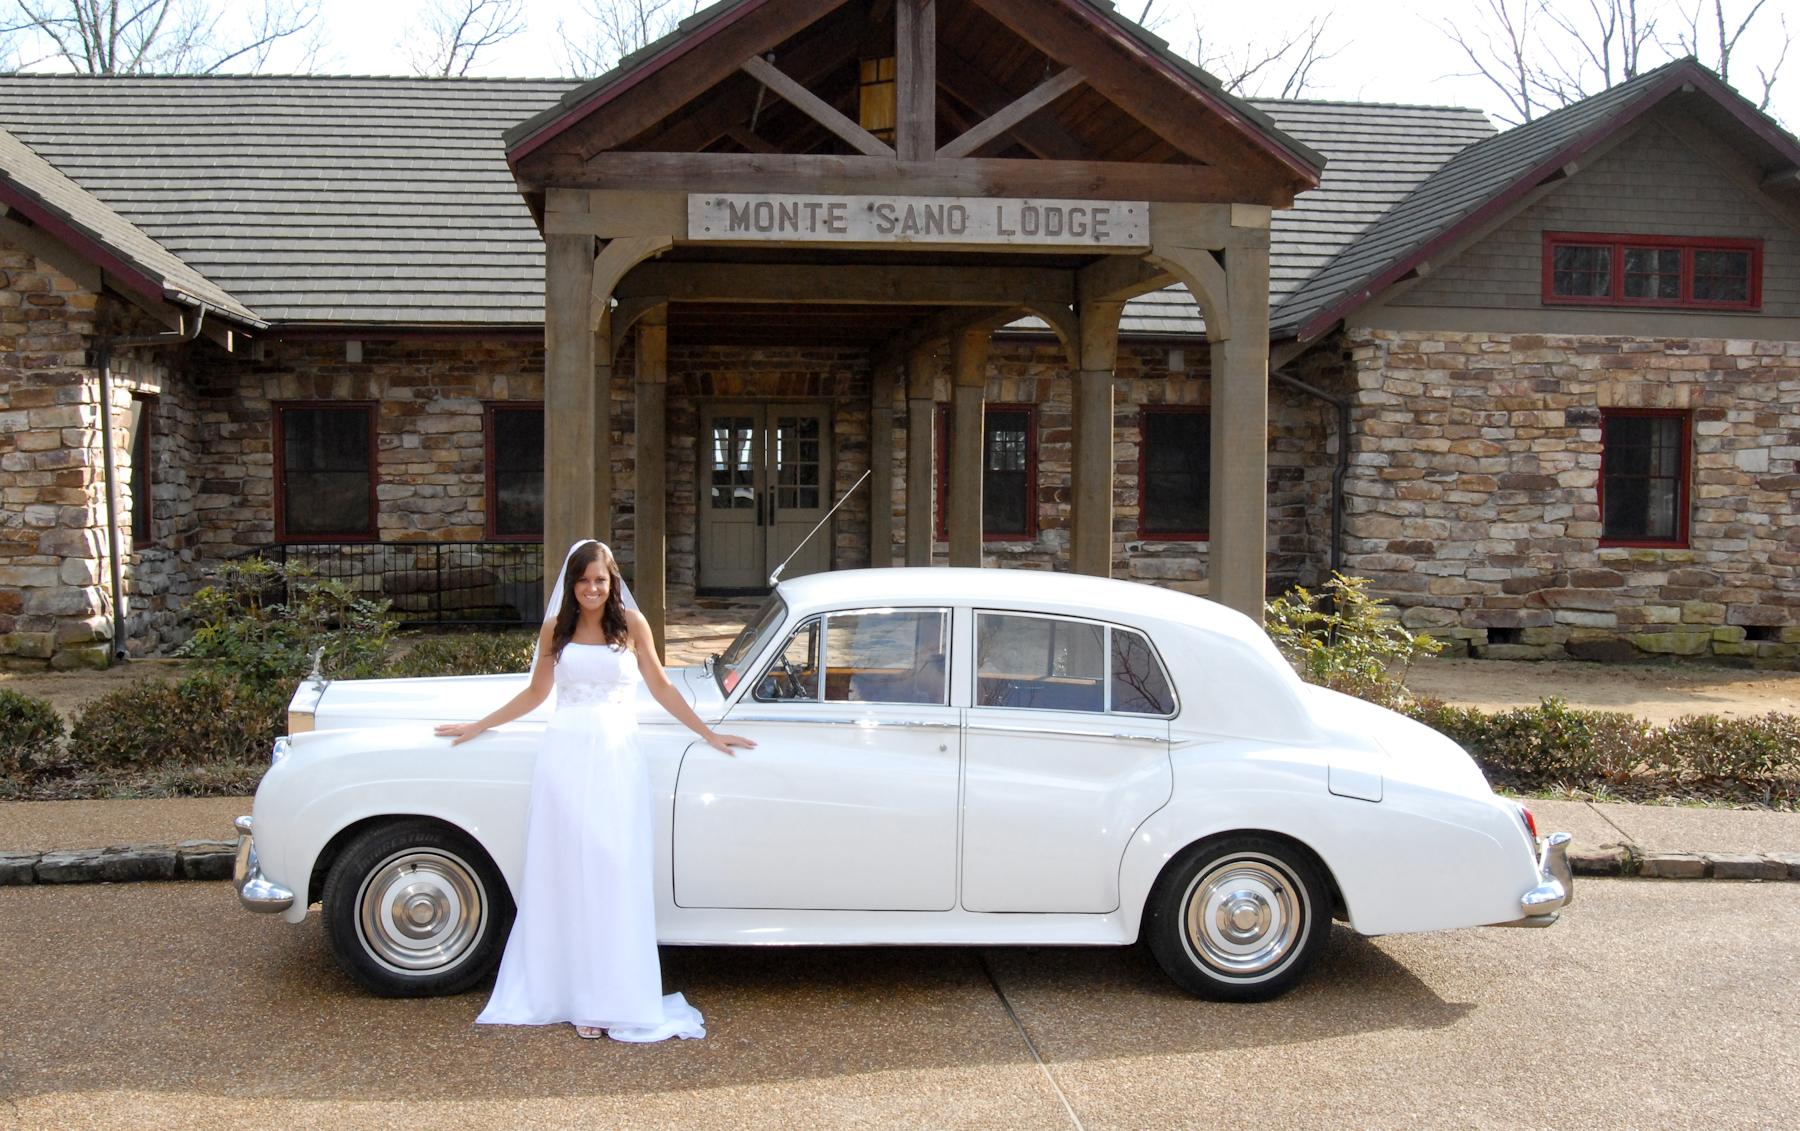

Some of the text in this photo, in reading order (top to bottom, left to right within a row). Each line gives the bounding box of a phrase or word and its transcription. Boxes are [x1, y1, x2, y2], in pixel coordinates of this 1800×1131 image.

[728, 200, 1111, 238] MONTE SANO LODGE
